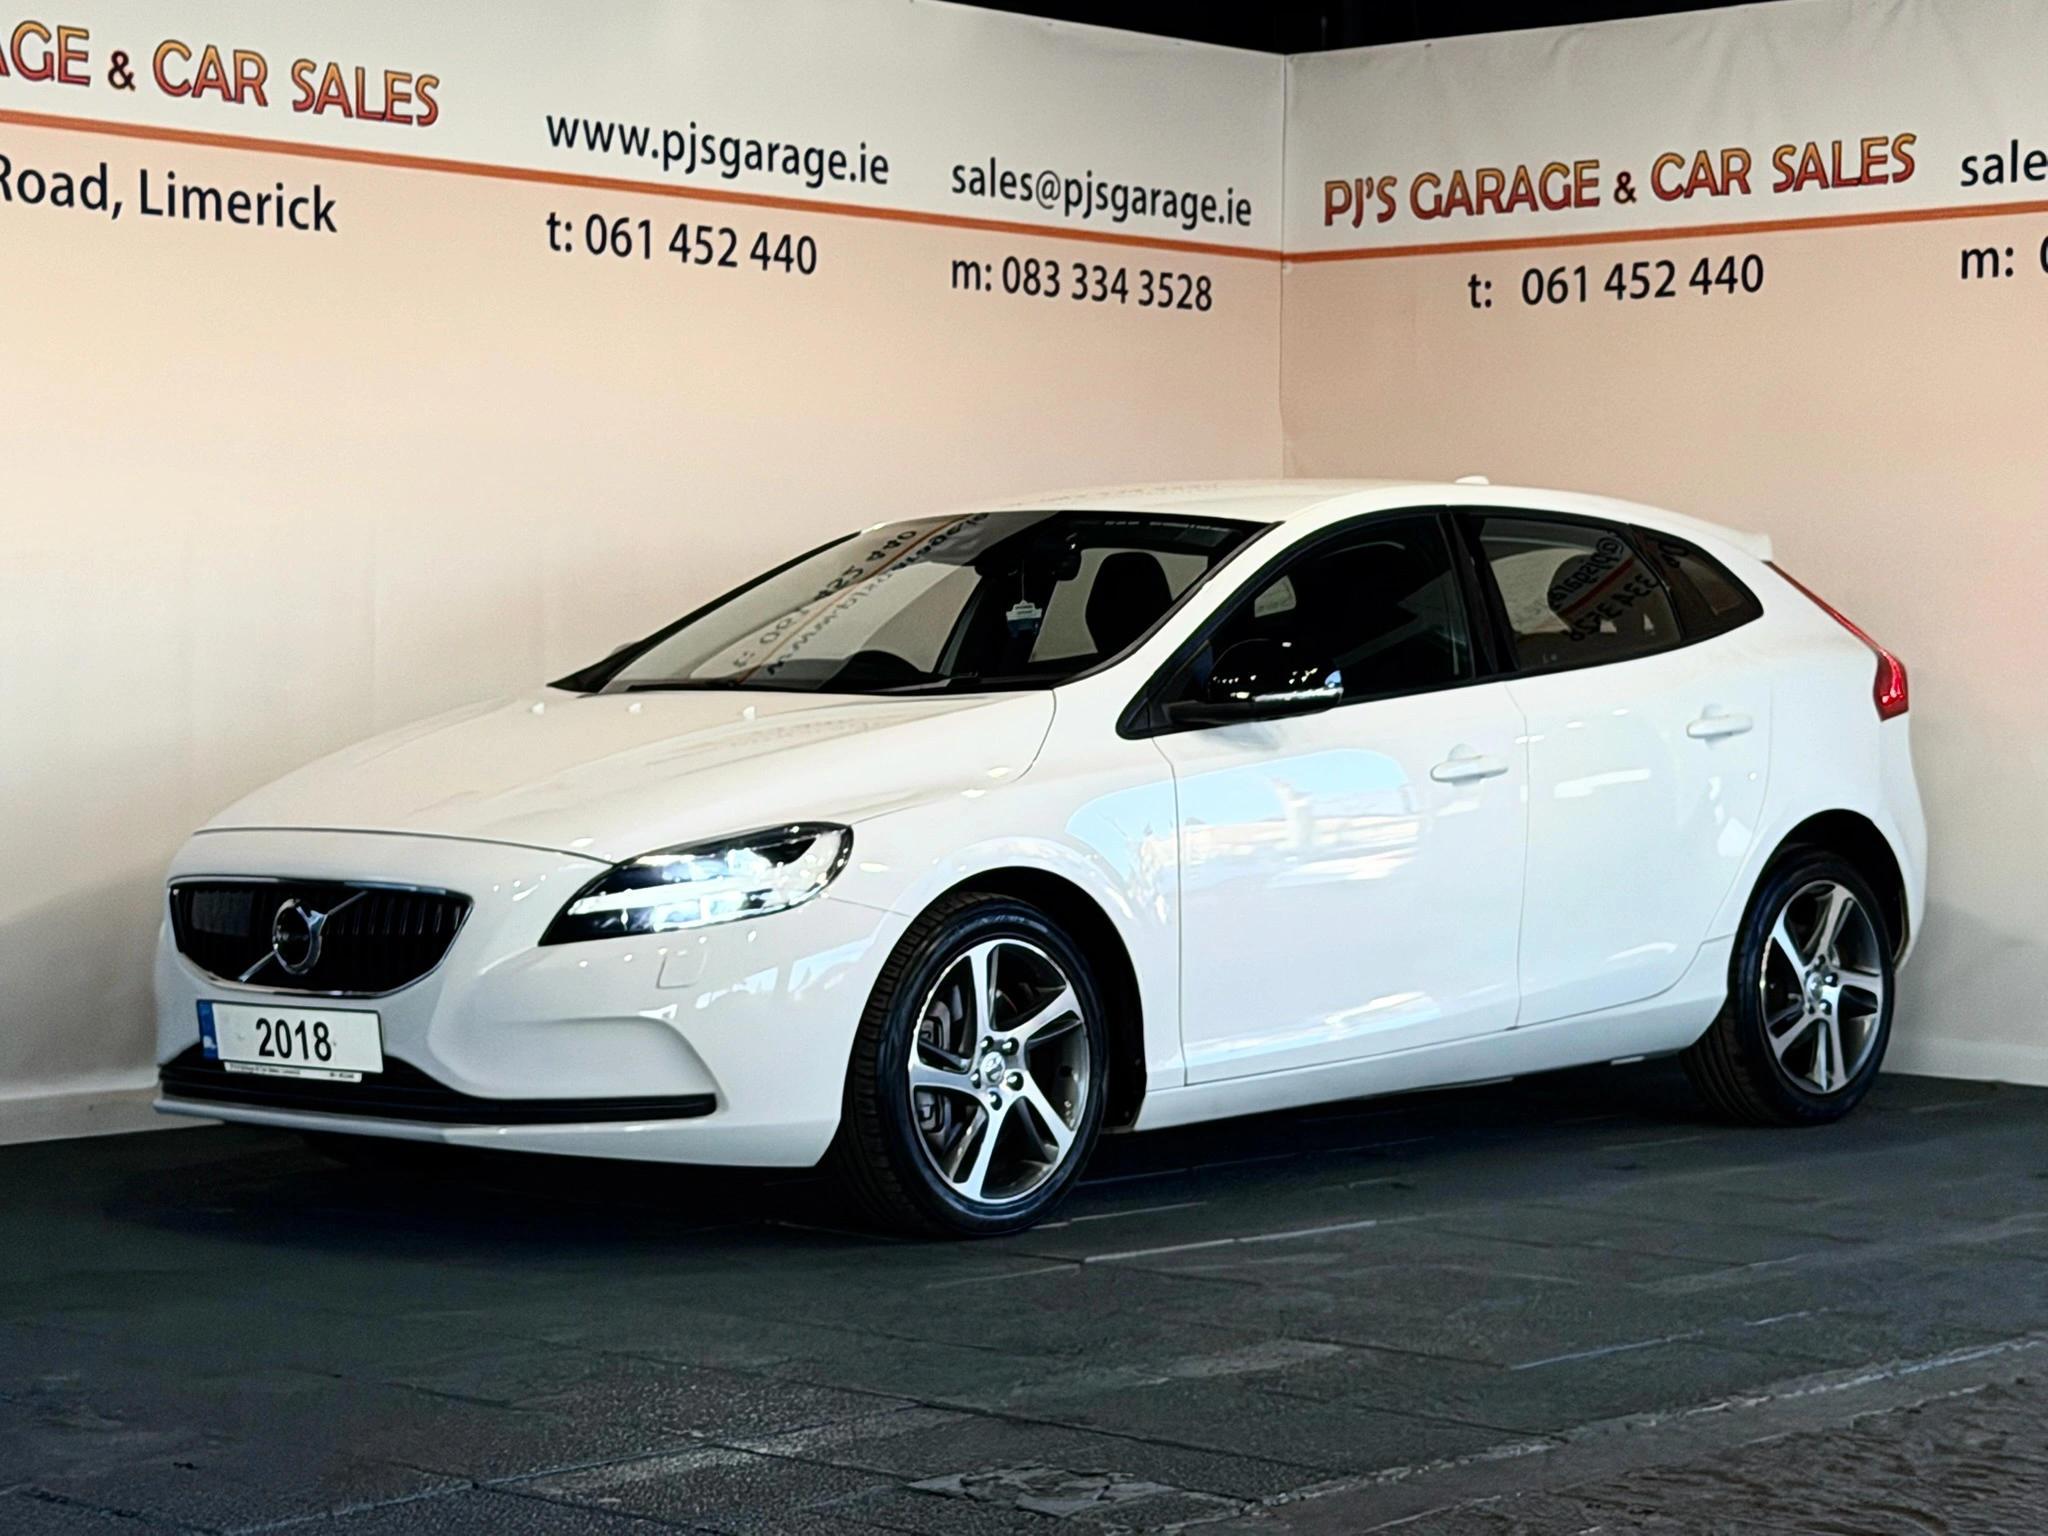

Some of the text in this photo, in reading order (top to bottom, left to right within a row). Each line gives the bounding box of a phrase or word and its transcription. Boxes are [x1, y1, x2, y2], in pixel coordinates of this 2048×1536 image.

[107, 50, 136, 92] &
[152, 39, 269, 108] CAR
[290, 58, 440, 128] SALES
[546, 114, 889, 188] www.pjsgarage.ie
[1324, 132, 1917, 229] PJ'S GARAGE & CAR SALES
[139, 168, 338, 233] Limerick
[951, 156, 1253, 230] sales@pjsgarage.ie
[546, 211, 817, 275] t: 061 452 440
[1961, 246, 2014, 280] m:
[951, 255, 1213, 312] m: 083 334 3528
[1467, 253, 1764, 309] t: 061 452 440
[256, 1017, 332, 1062] 2018
